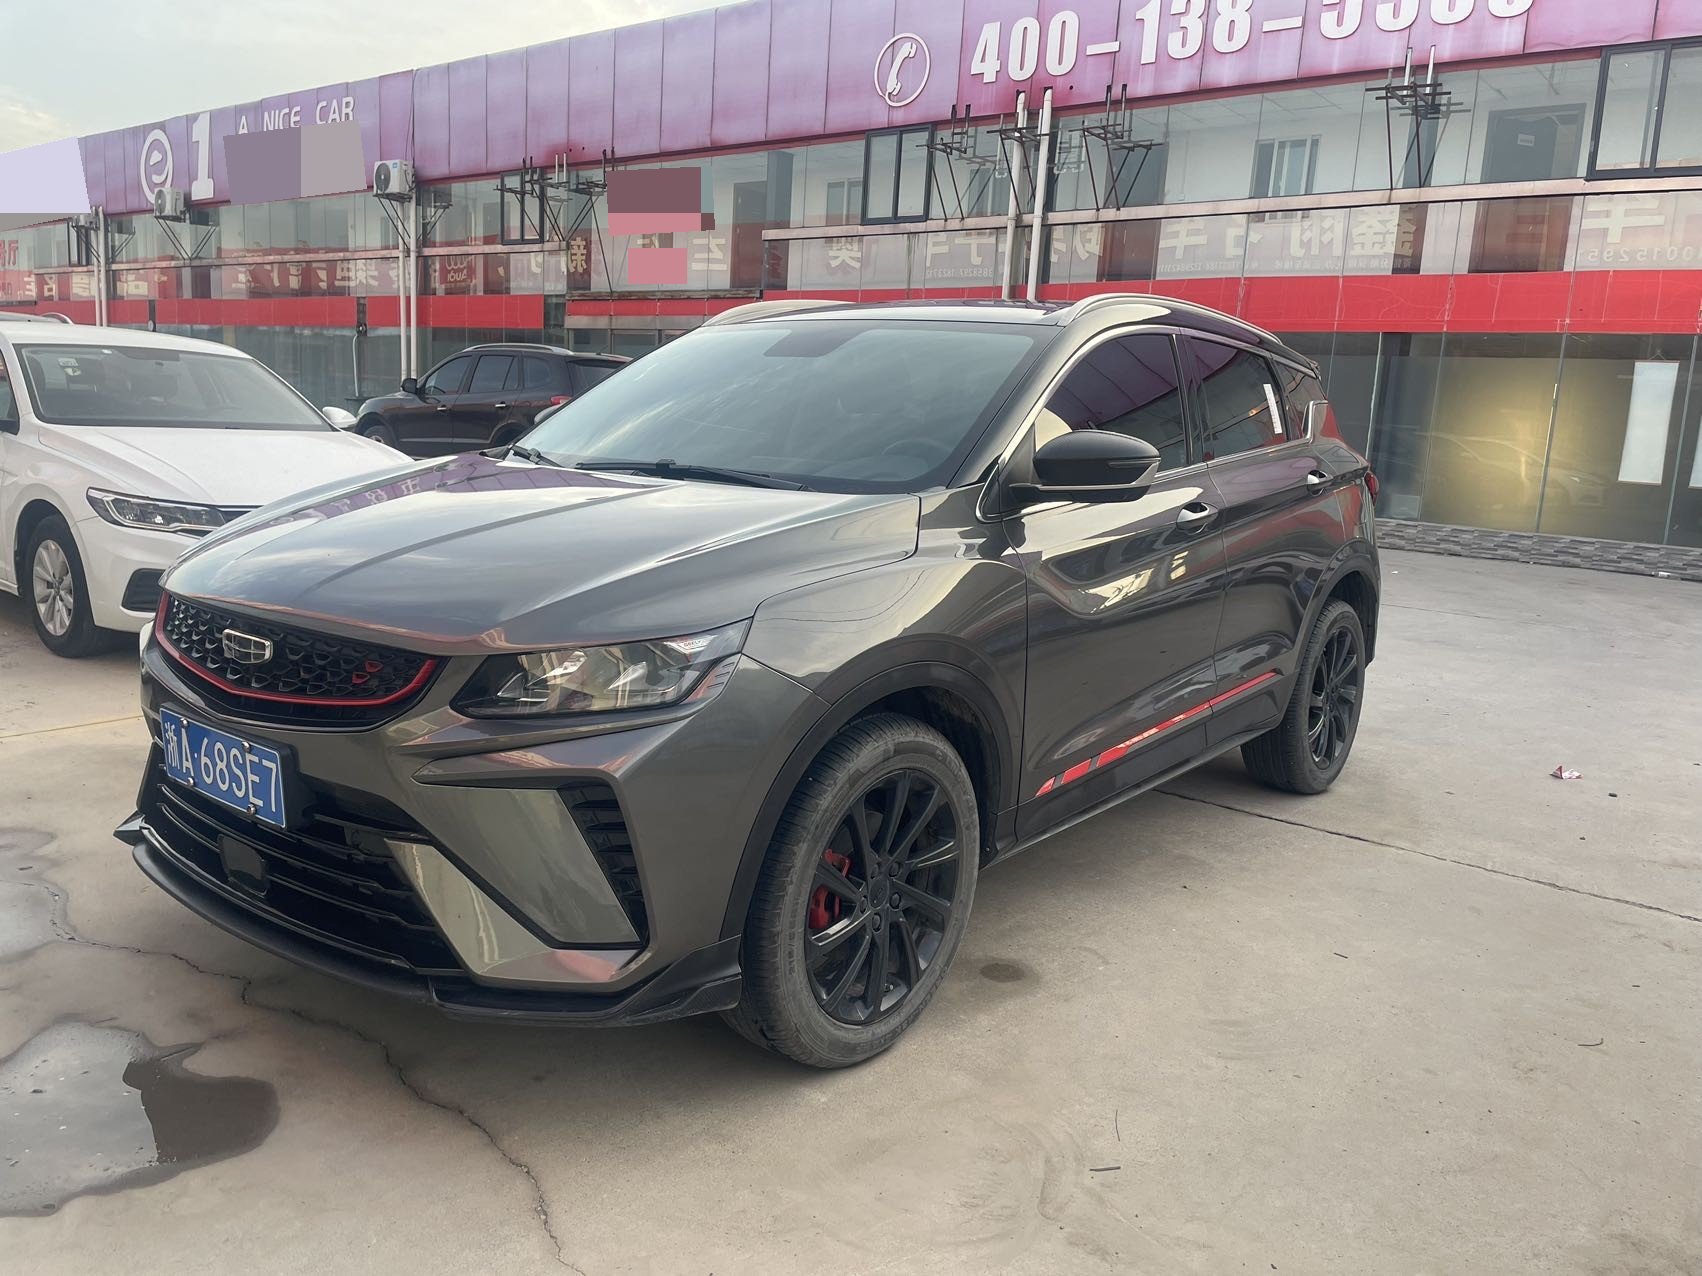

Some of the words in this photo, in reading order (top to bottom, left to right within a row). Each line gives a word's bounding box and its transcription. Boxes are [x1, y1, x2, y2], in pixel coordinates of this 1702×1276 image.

[970, 0, 1534, 84] 400-138-
[191, 111, 214, 201] 1
[238, 115, 249, 135] A
[263, 105, 301, 132] NICE
[315, 96, 355, 125] CAR
